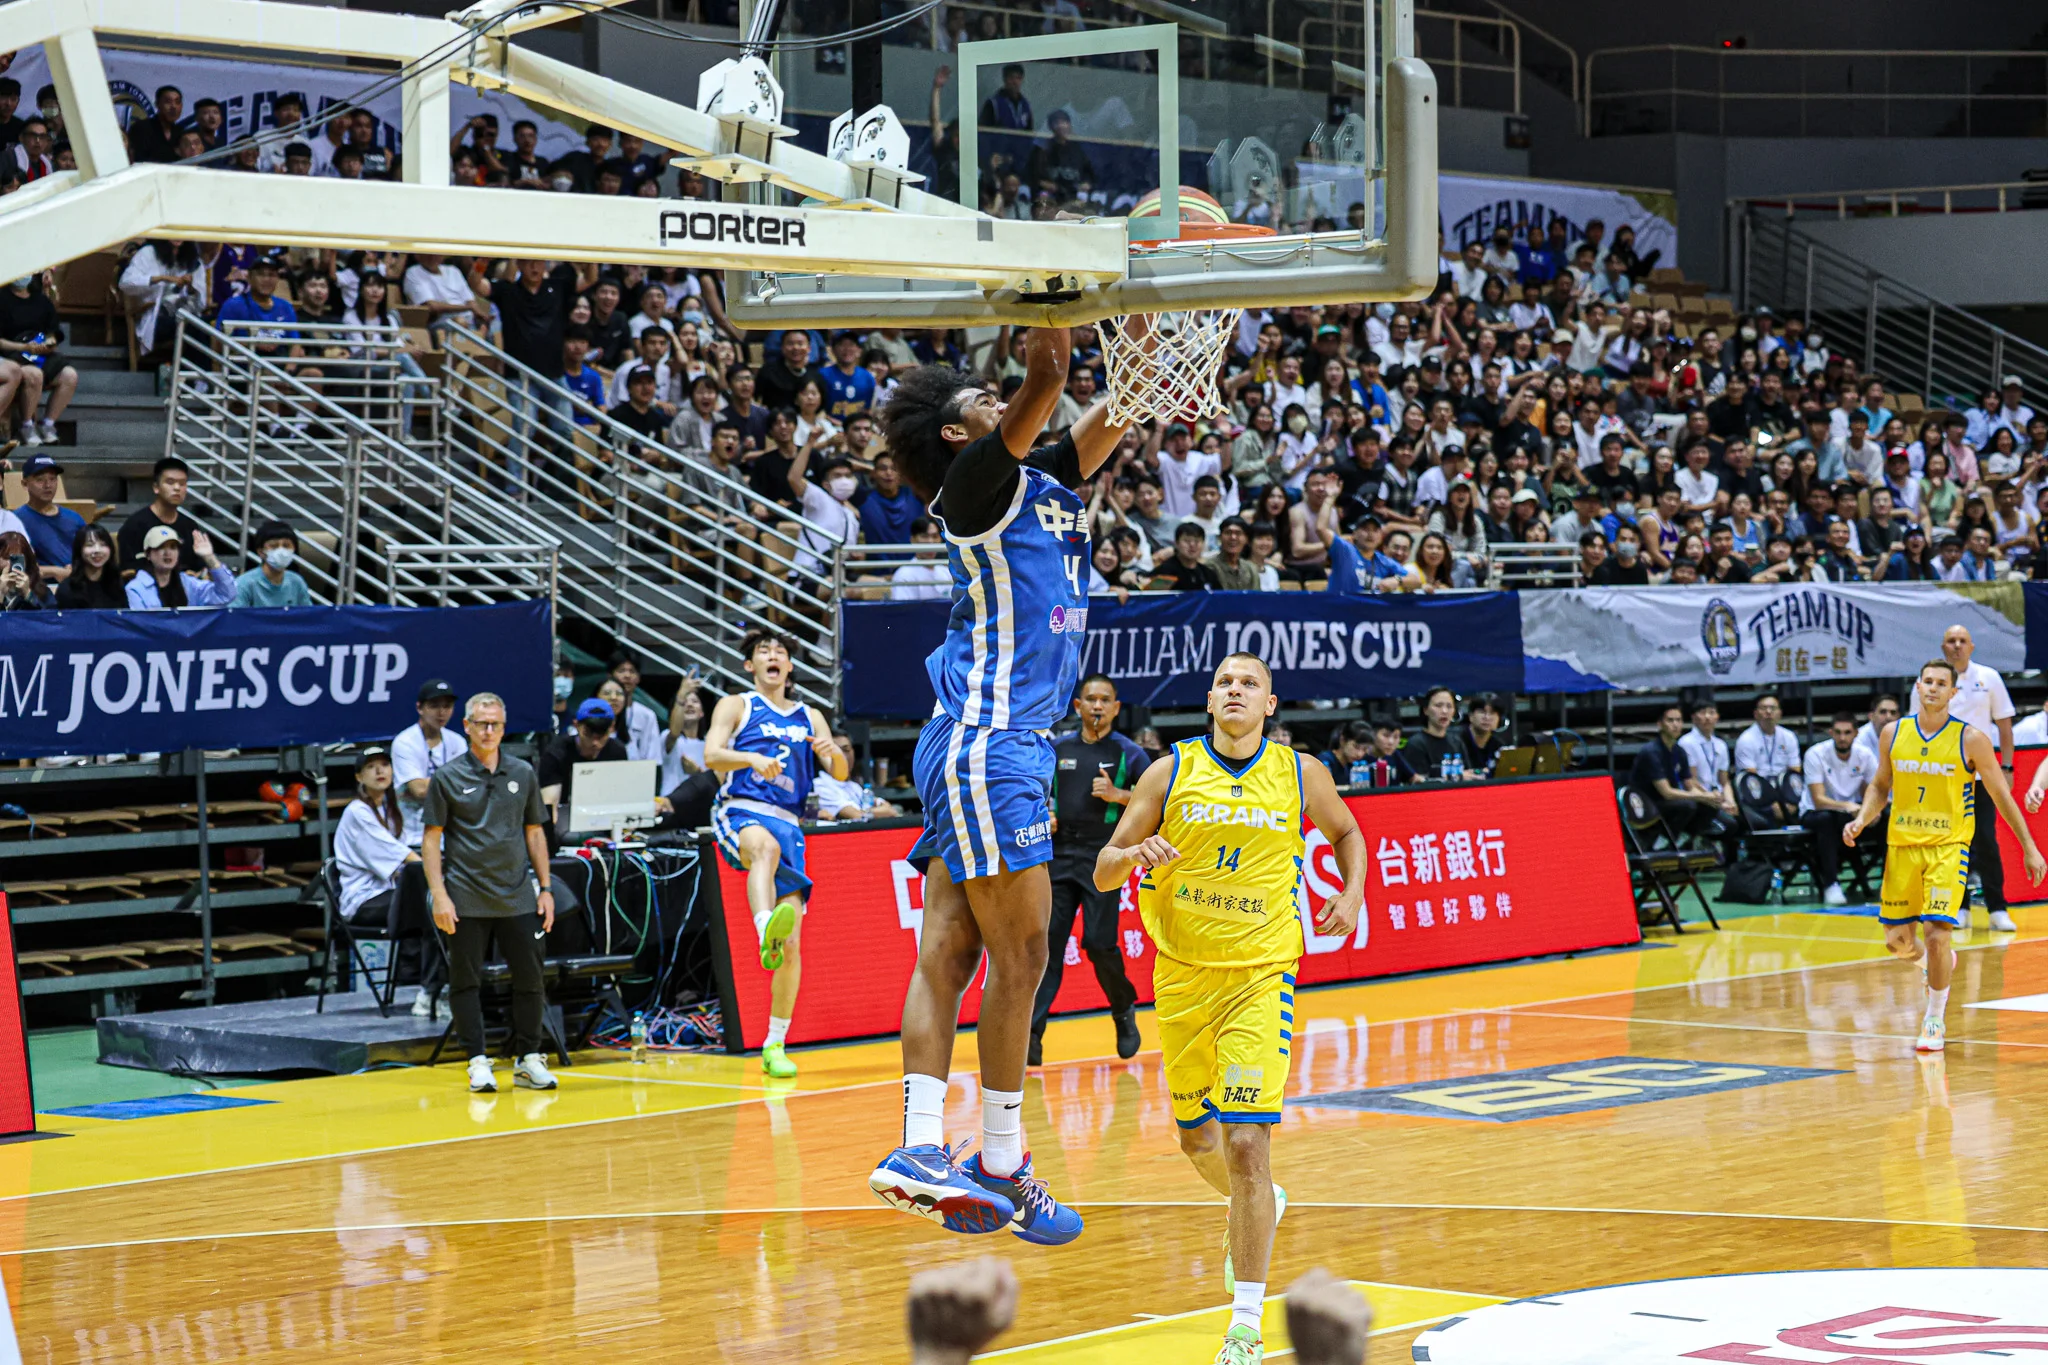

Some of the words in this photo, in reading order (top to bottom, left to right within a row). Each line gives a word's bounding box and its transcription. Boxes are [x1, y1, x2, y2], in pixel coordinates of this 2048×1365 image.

[1063, 555, 1082, 596] 4
[1224, 621, 1349, 671] JONES
[1351, 621, 1432, 669] CUP
[1748, 591, 1831, 666] TEAM
[1833, 596, 1874, 660] UP
[56, 646, 270, 734] JONES
[278, 643, 409, 706] CUP
[776, 744, 791, 768] 2
[1918, 786, 1926, 804] 7
[1181, 803, 1289, 833] UKRAINE
[1215, 845, 1242, 873] 14
[1375, 828, 1507, 888] 台新銀行
[1388, 892, 1513, 931] 智慧好夥伴
[1223, 1086, 1262, 1104] D-ACE
